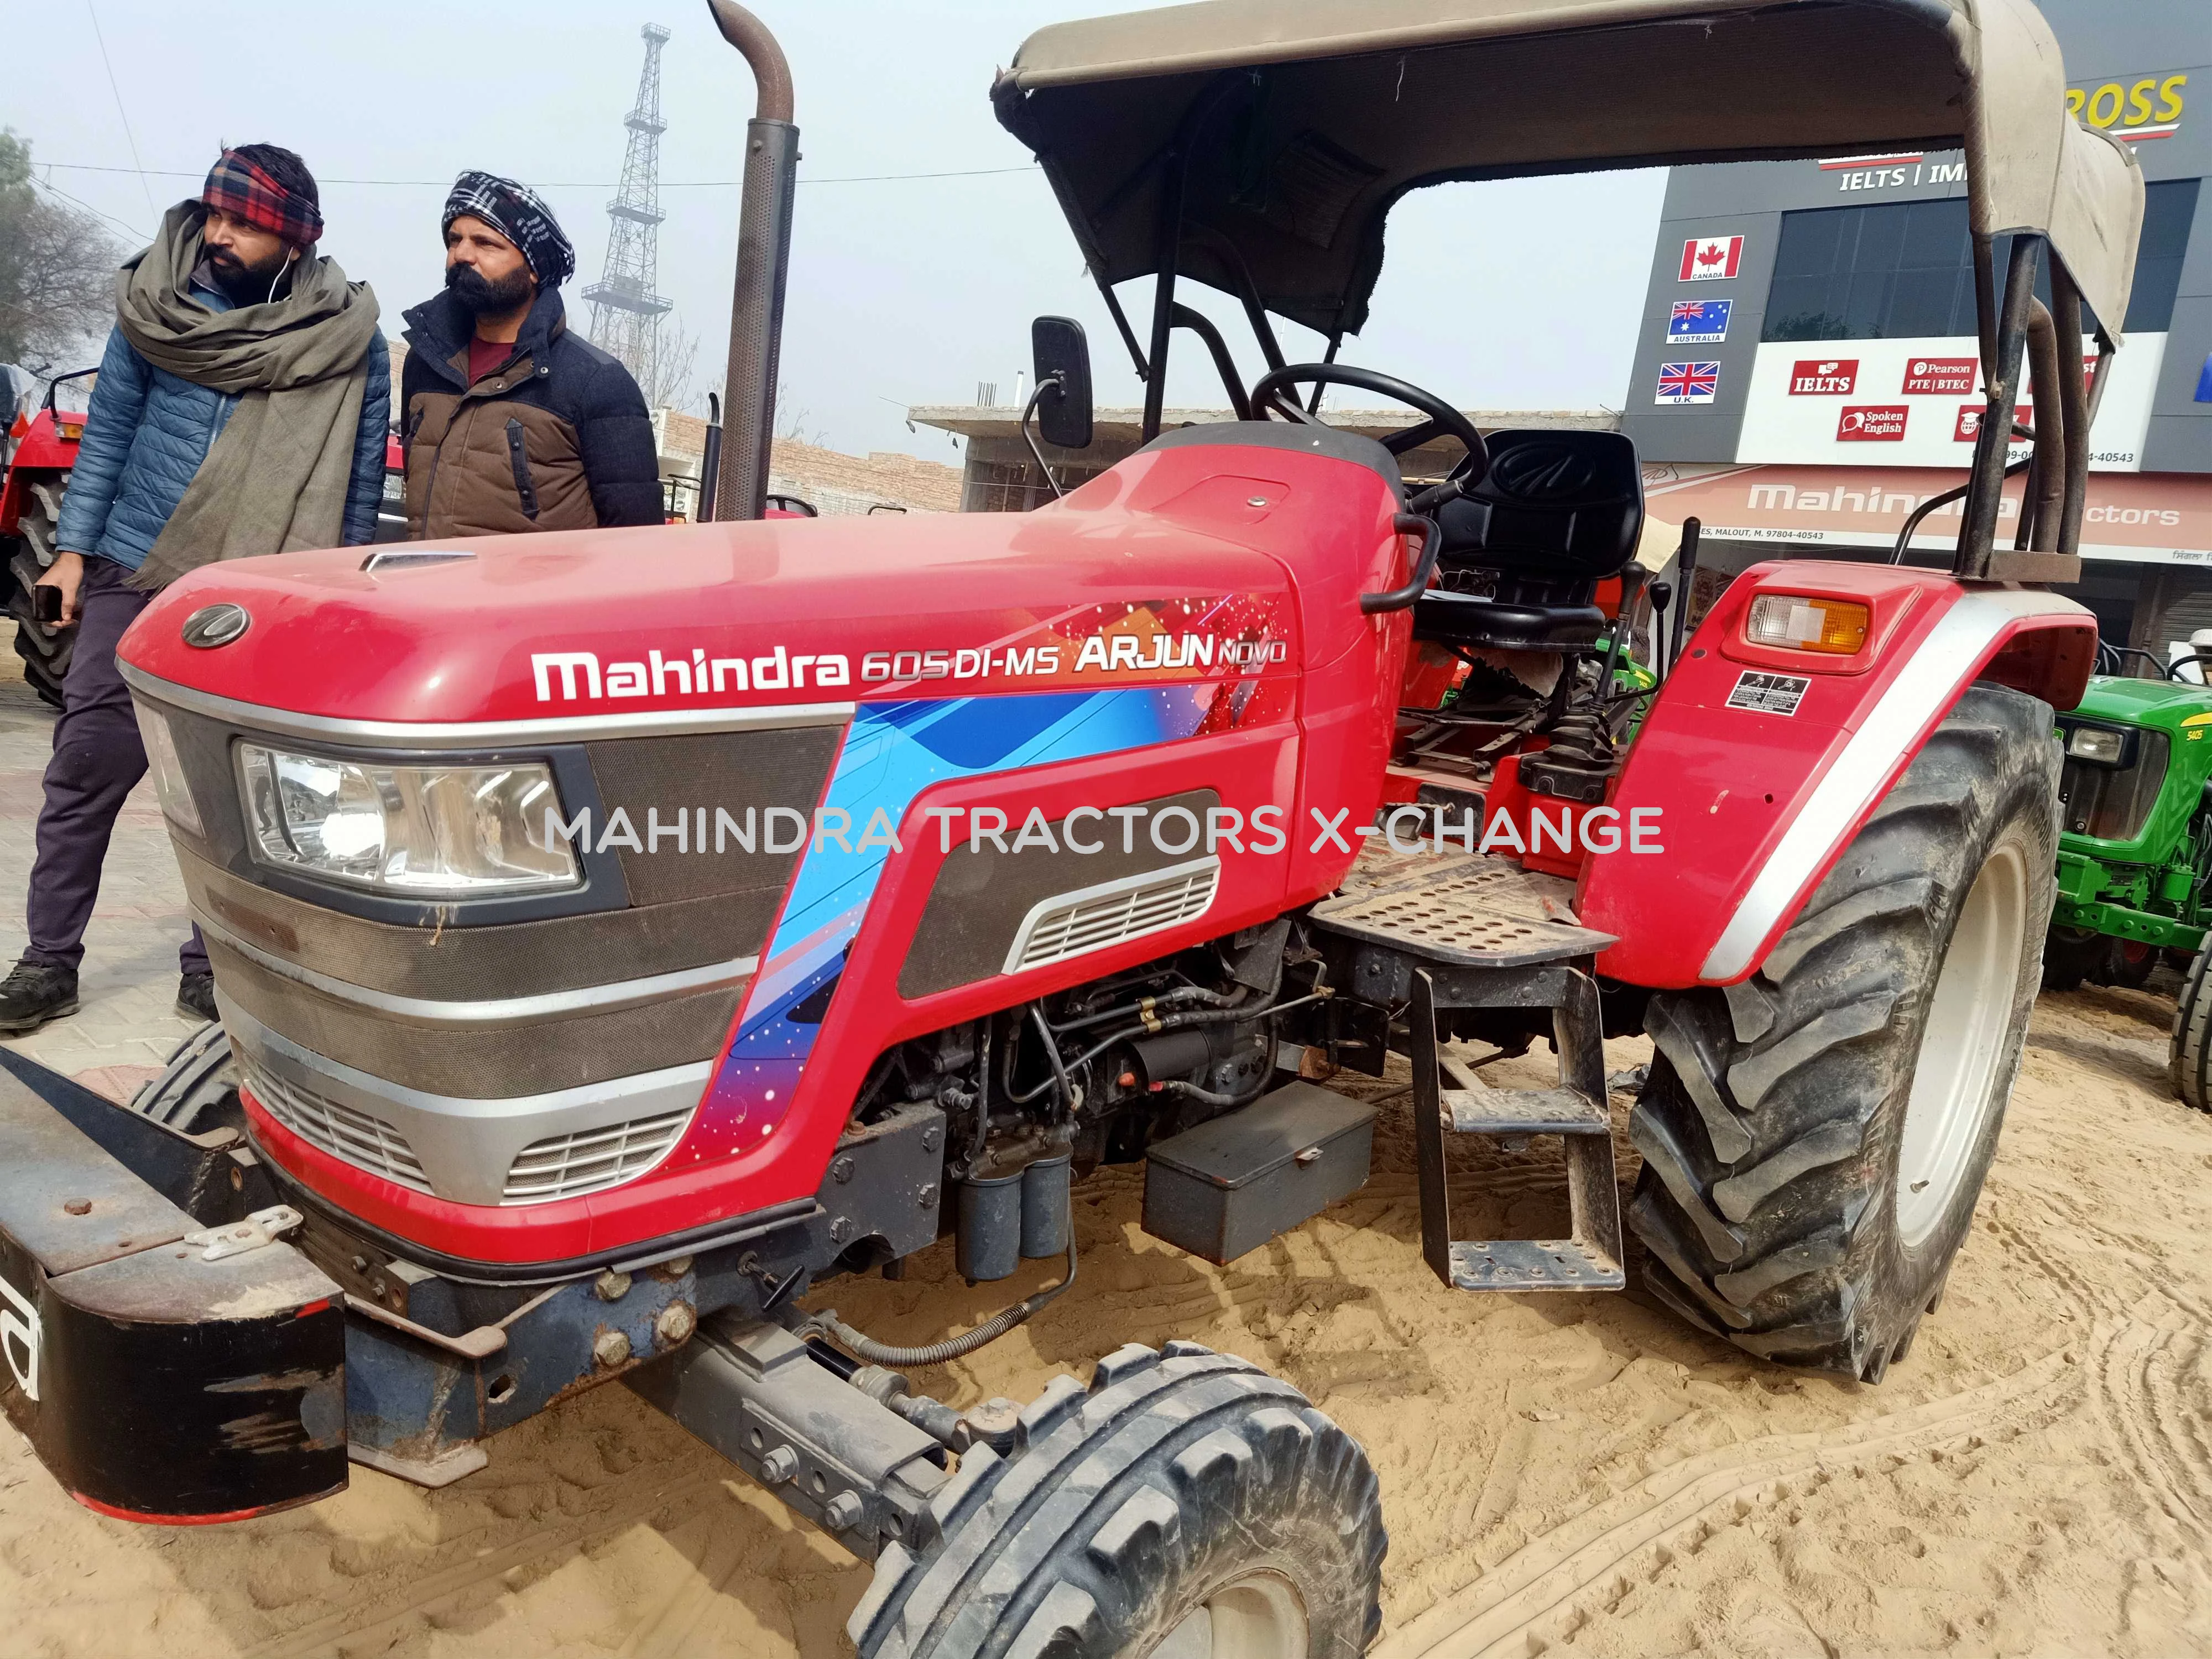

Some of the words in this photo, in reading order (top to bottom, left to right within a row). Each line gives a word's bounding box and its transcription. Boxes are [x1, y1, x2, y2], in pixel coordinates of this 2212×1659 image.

[1839, 168, 1906, 191] IELTS
[1929, 163, 1968, 184] IM
[1928, 364, 1970, 374] Pearson
[1794, 377, 1850, 392] IELTS
[1866, 411, 1903, 424] Spoken
[1863, 422, 1902, 435] English
[1747, 484, 2018, 518] Mahinda
[1715, 529, 1751, 537] MALOUT,
[1766, 530, 1824, 540] 97804-40543
[530, 646, 850, 701] Mahindra
[1073, 633, 1215, 673] ARJUN
[1218, 640, 1287, 665] NOVO
[2186, 729, 2203, 741] 5405
